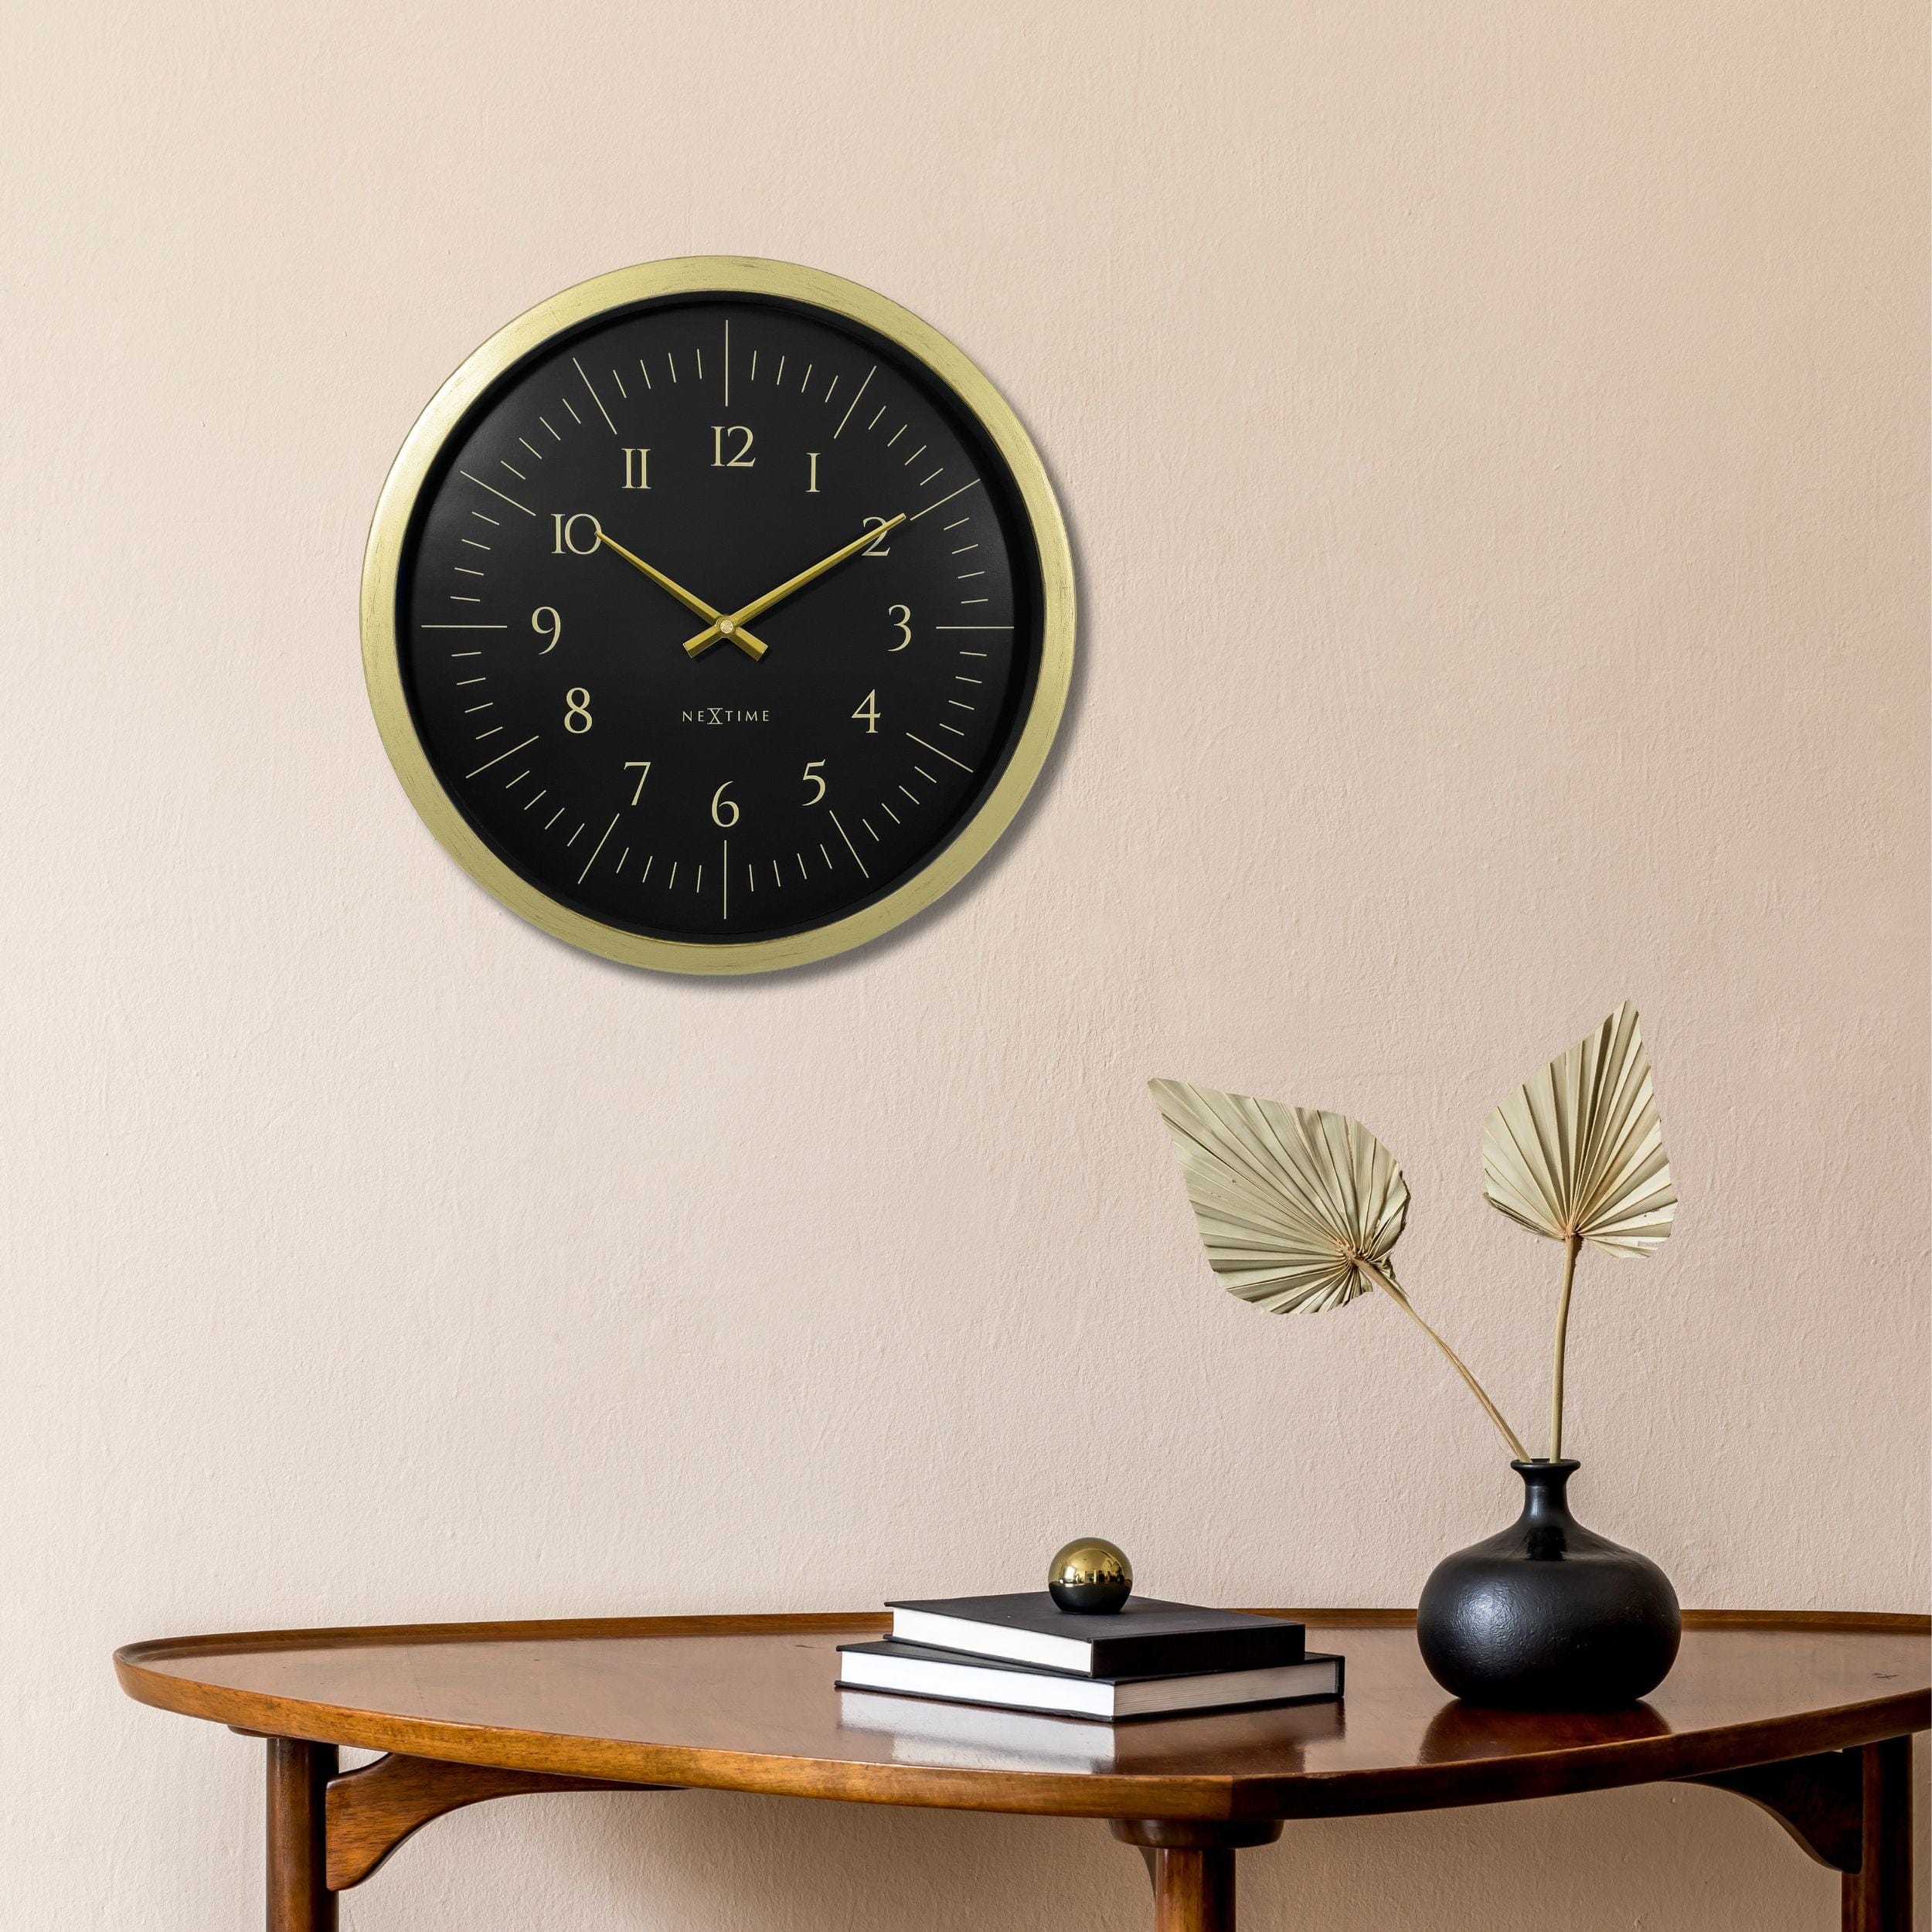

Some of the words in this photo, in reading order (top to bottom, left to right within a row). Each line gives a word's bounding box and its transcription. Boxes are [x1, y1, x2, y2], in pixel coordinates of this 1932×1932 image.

[621, 447, 652, 489] 11
[710, 425, 756, 468] 12
[805, 452, 821, 493] 1
[550, 513, 602, 555] 10
[862, 516, 891, 556] 2
[531, 606, 561, 655] 9
[887, 604, 912, 651] 3
[563, 687, 593, 734] 8
[682, 707, 770, 725] NEXTIME
[851, 689, 882, 733] 4
[624, 761, 651, 806] 7
[801, 758, 826, 806] 5
[711, 781, 740, 828] 6
